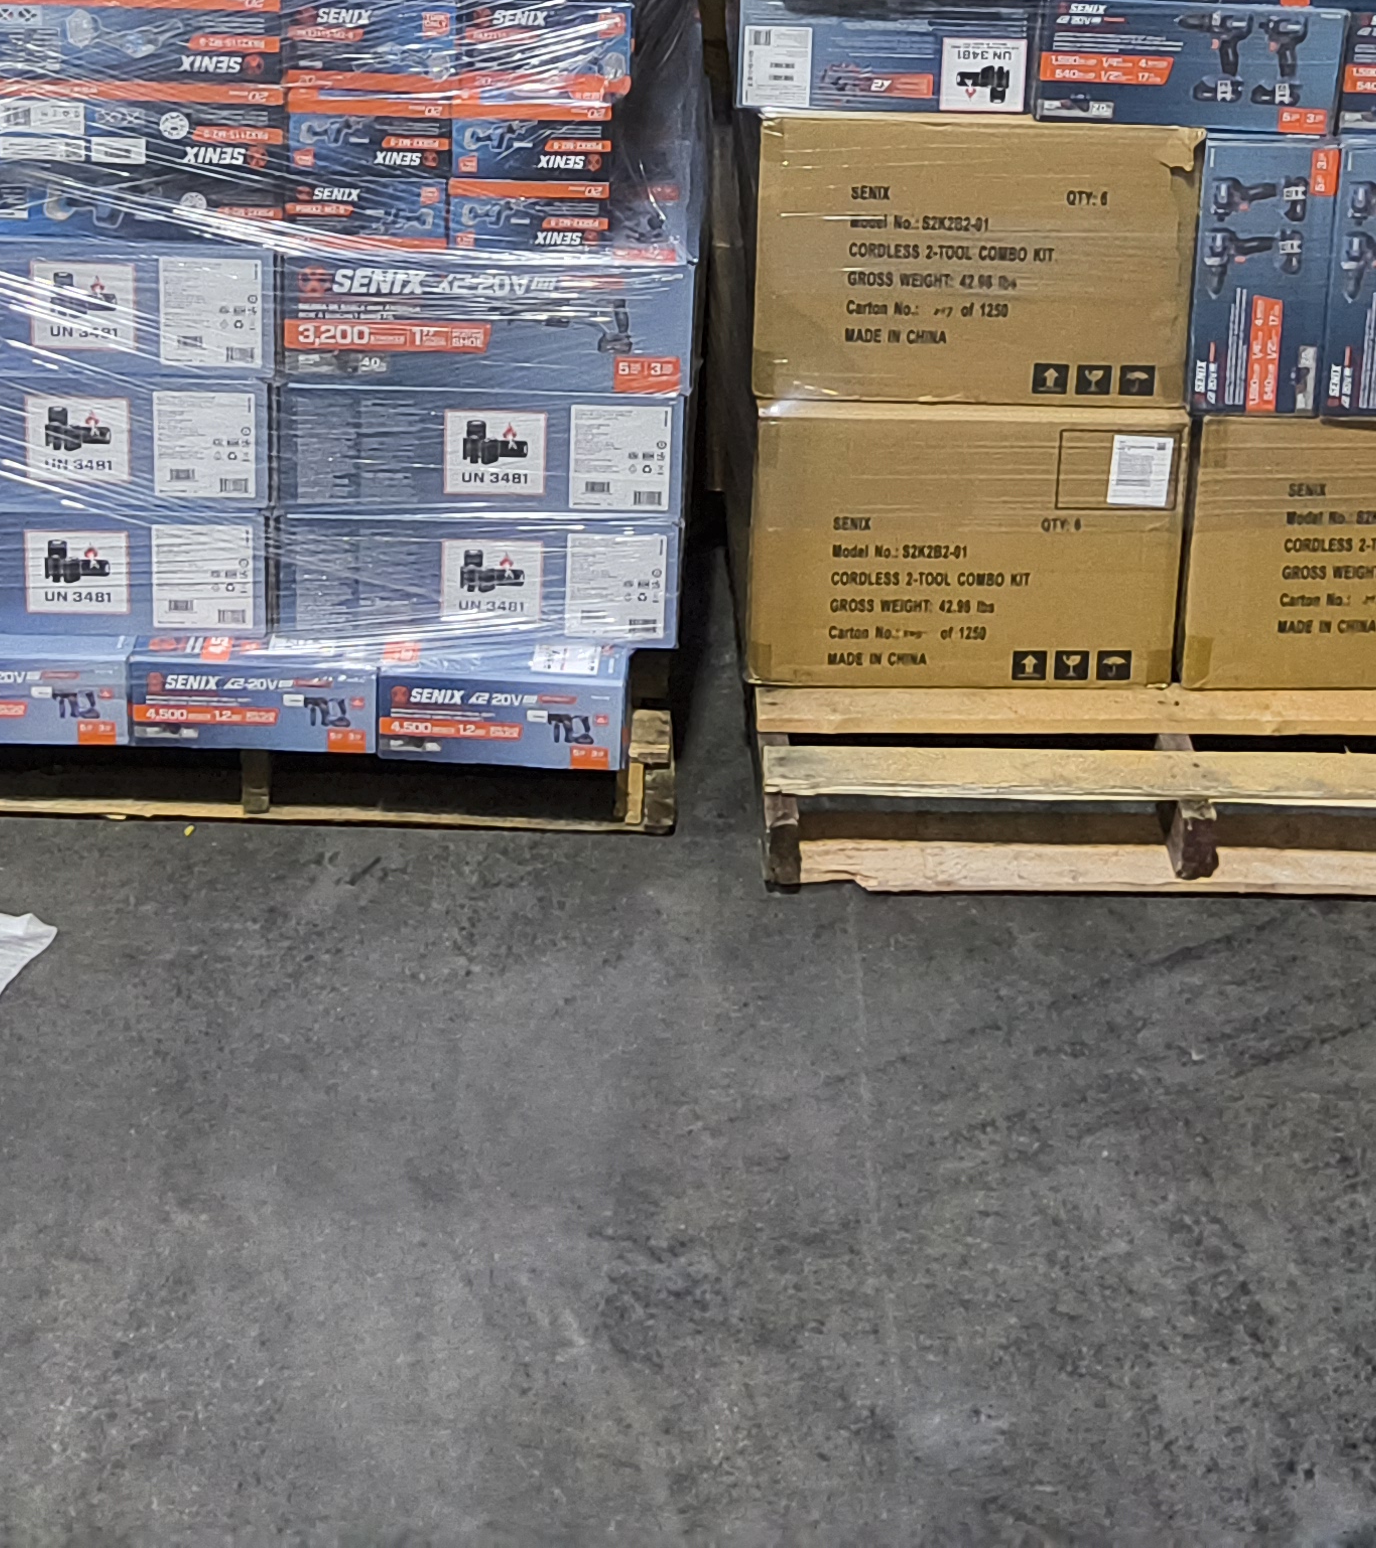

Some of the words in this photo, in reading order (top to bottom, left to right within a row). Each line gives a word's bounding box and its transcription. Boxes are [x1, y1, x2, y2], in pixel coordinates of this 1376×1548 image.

[316, 8, 372, 25] SENIX
[1069, 3, 1106, 15] SENIX
[492, 9, 547, 26] SENIX
[179, 54, 243, 74] SENIX
[182, 146, 247, 165] SENIX
[373, 151, 422, 167] SENIX
[537, 155, 586, 170] SENIX
[312, 186, 360, 201] SENIX
[851, 186, 891, 201] SENIX
[1066, 190, 1097, 206] QTY:
[535, 231, 582, 245] SENIX
[848, 242, 921, 261] CORDLESS
[925, 245, 973, 261] 2-TOOL
[978, 246, 1028, 262] COMBO
[1033, 248, 1055, 263] KIT
[332, 267, 429, 295] SENIX
[847, 271, 894, 287] GROSS
[899, 272, 954, 288] WEIGHT:
[846, 300, 888, 316] Carton
[960, 302, 974, 318] of
[980, 303, 1009, 318] 1250
[50, 326, 73, 337] UN
[297, 325, 371, 346] 3,200
[844, 328, 882, 344] MADE
[887, 329, 901, 344] IN
[906, 330, 947, 345] CHINA
[74, 459, 113, 471] 3481
[462, 473, 485, 483] UN
[489, 473, 528, 484] 3481
[1287, 483, 1327, 498] SENIX
[833, 516, 872, 531] SENIX
[1041, 516, 1070, 532] QTY:
[832, 544, 869, 559] Model
[902, 544, 968, 559] S2K2B2-01
[1283, 538, 1354, 553] CORDLESS
[830, 571, 901, 586] CORDLESS
[905, 571, 951, 586] 2-TOOL
[957, 571, 1005, 587] COMBO
[1010, 571, 1031, 586] KIT
[1281, 565, 1327, 580] GROSS
[45, 591, 68, 602] UN
[73, 591, 112, 603] 3481
[1279, 592, 1321, 607] Carton
[458, 601, 482, 612] UN
[486, 601, 525, 612] 3481
[830, 599, 874, 613] GROSS
[880, 599, 932, 613] WEIGHT:
[976, 600, 995, 613] lbs
[828, 625, 869, 640] Carton
[940, 626, 954, 640] of
[959, 625, 987, 640] 1250
[1277, 620, 1314, 634] MADE
[1319, 620, 1332, 634] IN
[1337, 619, 1376, 634] CHINA
[827, 651, 863, 666] MADE
[869, 652, 882, 665] IN
[887, 651, 928, 666] CHINA
[165, 674, 222, 690] SENIX
[246, 678, 278, 691] 20V
[410, 688, 465, 705] SENIX
[490, 693, 524, 706] 20V
[145, 708, 187, 720] 4,500
[390, 721, 432, 734] 4,500
